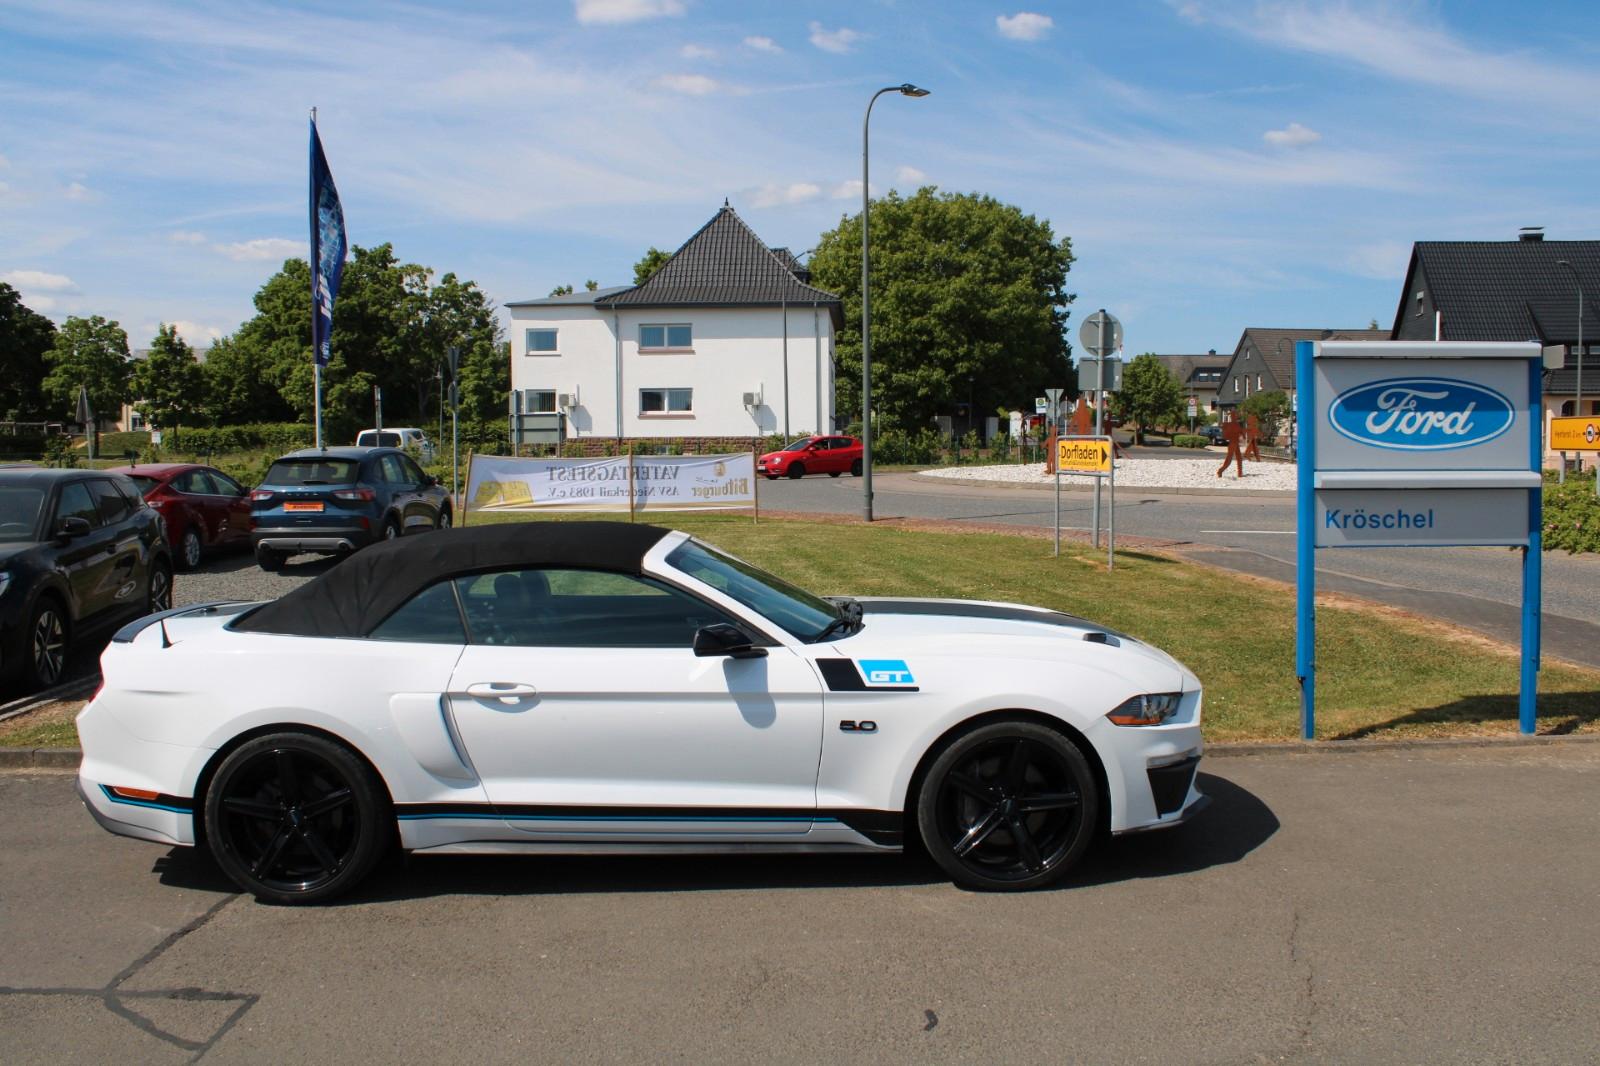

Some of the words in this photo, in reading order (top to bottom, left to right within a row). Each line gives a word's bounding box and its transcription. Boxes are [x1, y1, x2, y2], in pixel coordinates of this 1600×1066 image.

[1365, 388, 1477, 435] Ford
[1060, 444, 1098, 460] Dorfladen
[1325, 509, 1434, 529] Kröschel
[870, 670, 909, 682] GT
[840, 720, 877, 731] 5.0
